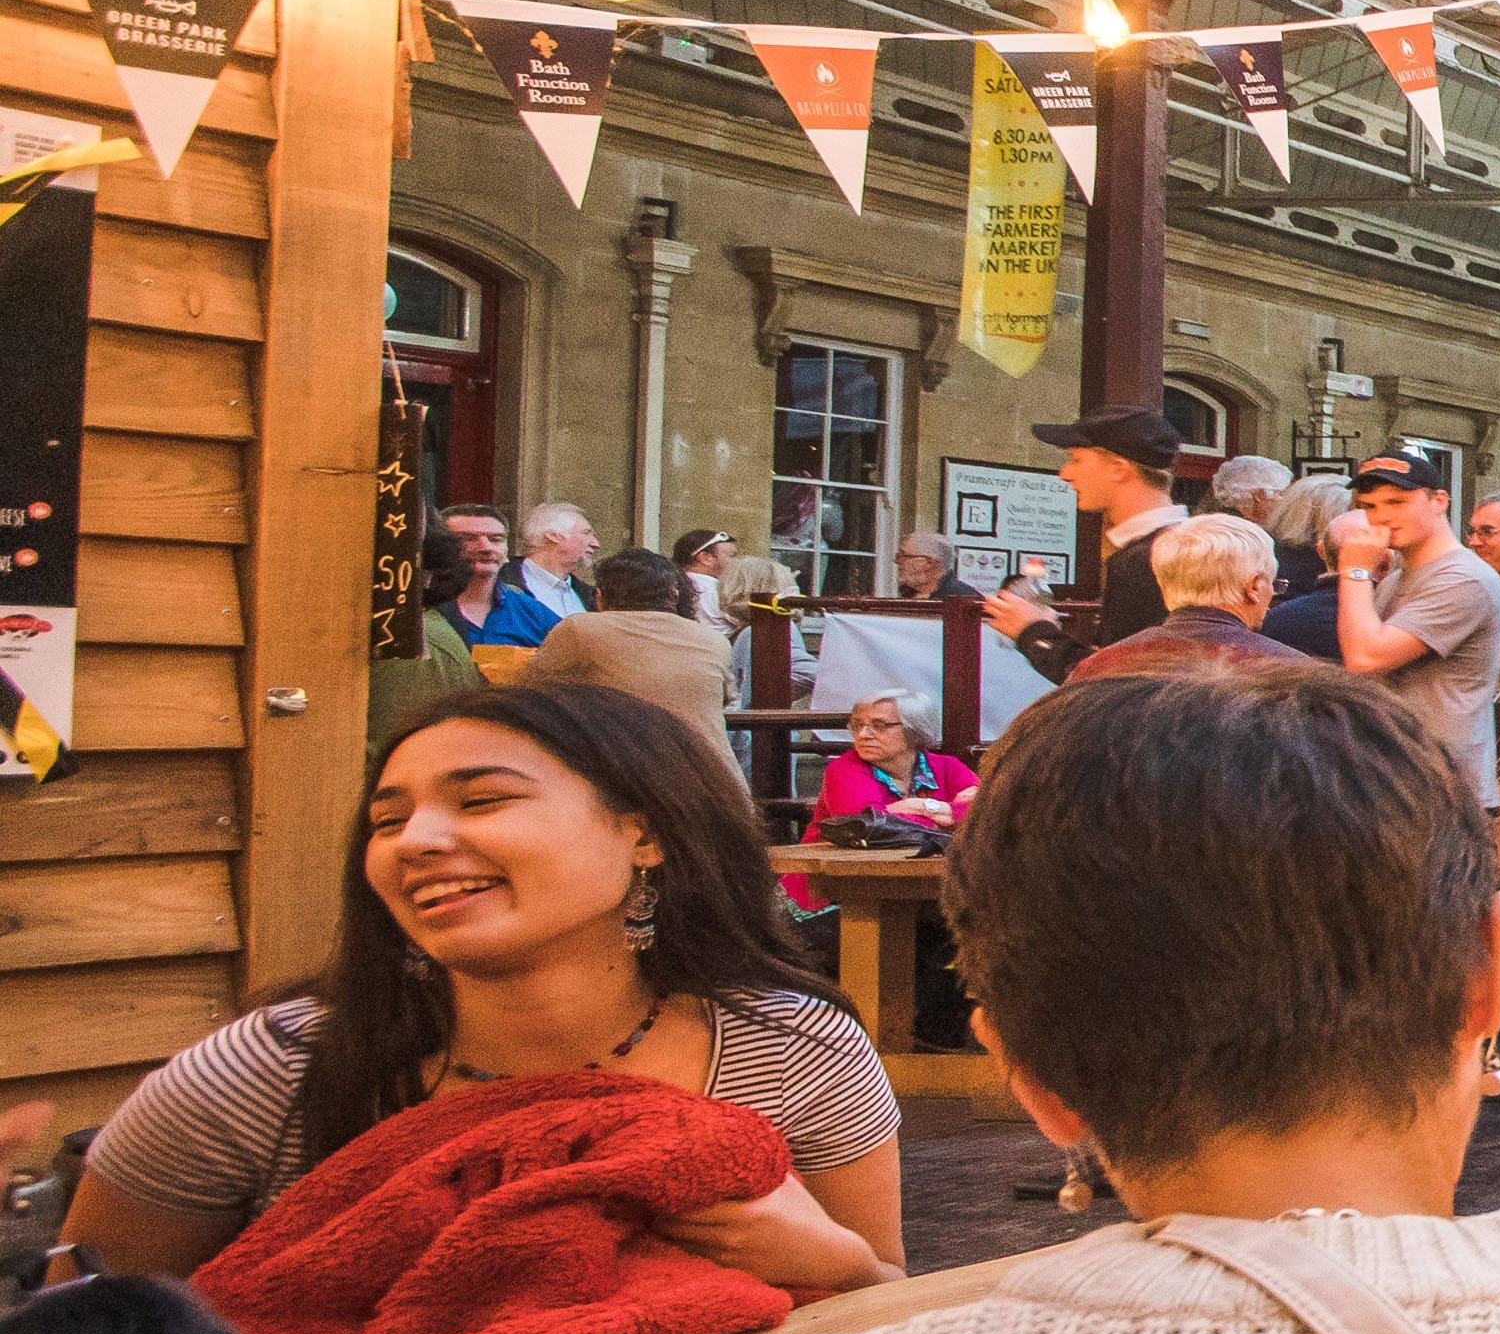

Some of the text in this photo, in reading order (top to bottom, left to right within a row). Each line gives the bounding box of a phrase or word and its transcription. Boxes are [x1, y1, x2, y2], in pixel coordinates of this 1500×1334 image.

[105, 10, 227, 41] GREEN PARK
[115, 27, 225, 56] BRASSERIE
[529, 59, 571, 75] Bath
[516, 73, 590, 91] Function
[1242, 71, 1266, 83] Bath
[1032, 86, 1091, 97] GREEN PARK
[1239, 82, 1278, 95] Function
[528, 88, 586, 106] Rooms
[1040, 98, 1093, 109] BRASSERIE
[1247, 95, 1278, 106] Rooms
[986, 205, 1062, 220] THE FIRST
[982, 223, 1060, 238] FARMERS
[989, 241, 1058, 256] MARKET
[1004, 259, 1031, 274] THE
